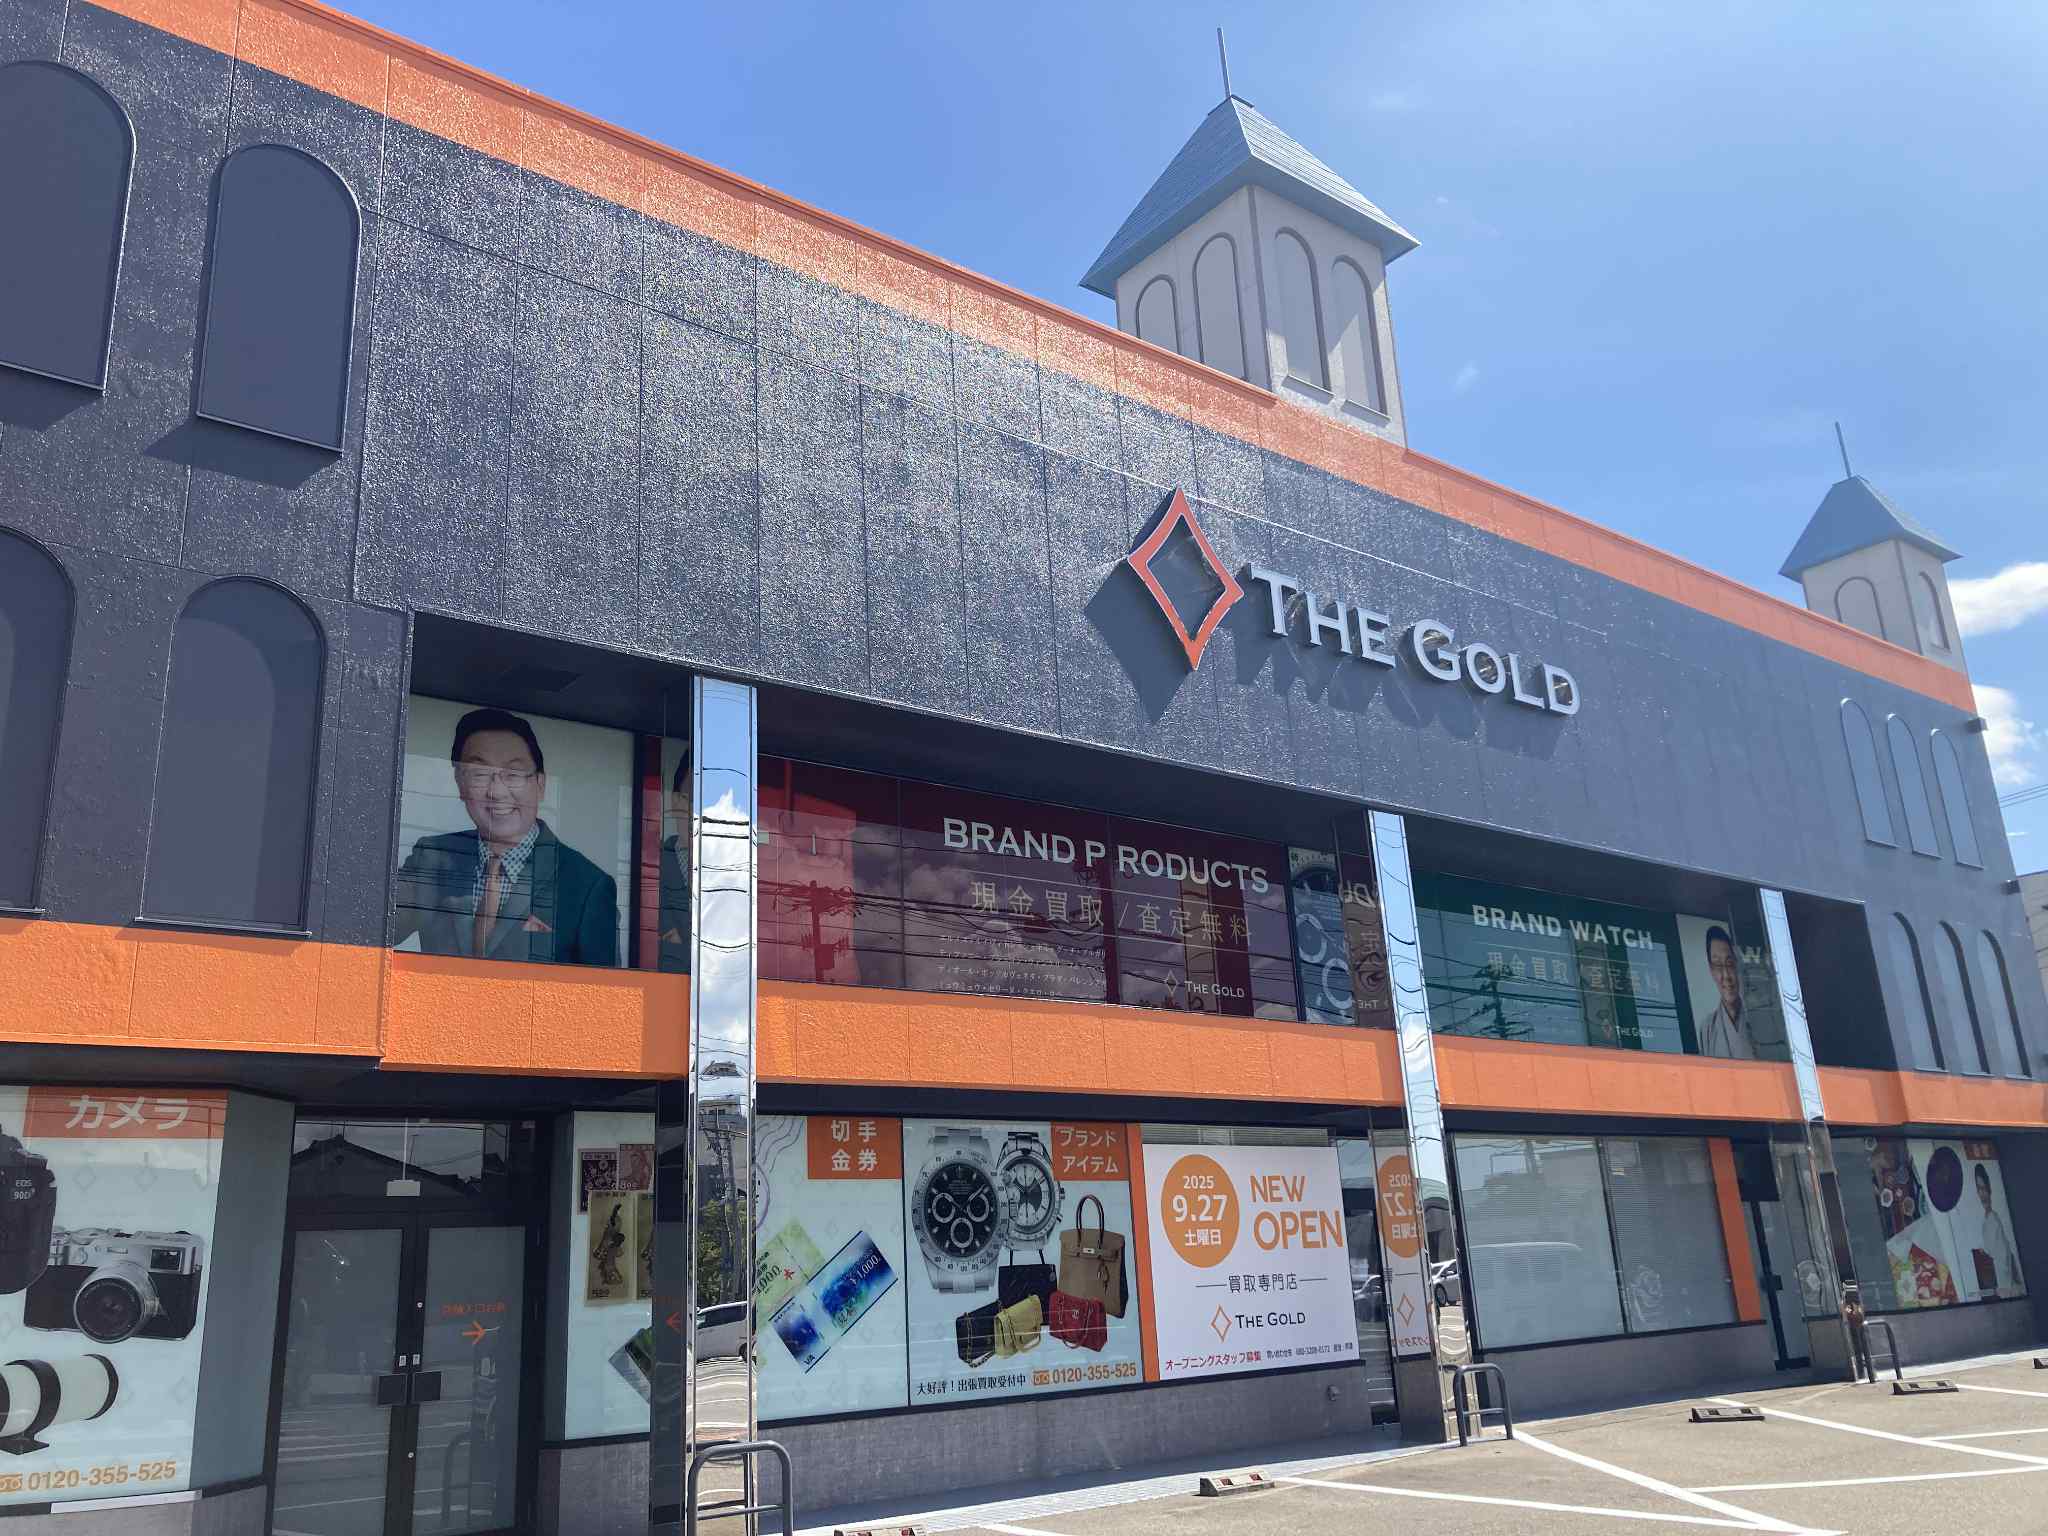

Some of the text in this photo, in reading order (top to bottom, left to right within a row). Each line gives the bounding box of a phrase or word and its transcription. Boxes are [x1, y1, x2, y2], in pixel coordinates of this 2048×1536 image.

[1249, 562, 1580, 715] THE GOLD
[943, 816, 1076, 865] BRAND
[1472, 904, 1654, 950] BRAND WATCH
[1184, 981, 1245, 999] THE GOLD
[65, 1094, 191, 1131] カメラ
[830, 1119, 878, 1141] 切手
[1058, 1127, 1118, 1149] ブランド
[830, 1148, 879, 1172] 金券
[1062, 1155, 1120, 1174] アイテム
[1183, 1175, 1215, 1190] 2025
[1250, 1175, 1306, 1203] NEW
[1172, 1194, 1228, 1222] 9.27
[1184, 1228, 1222, 1248] 土曜日
[1253, 1210, 1344, 1251] OPEN
[1228, 1273, 1298, 1293] 買取専門店
[1235, 1312, 1306, 1329] THE GOLD
[1053, 1362, 1137, 1385] 0120-355-525
[28, 1461, 177, 1491] 0120-355-525
